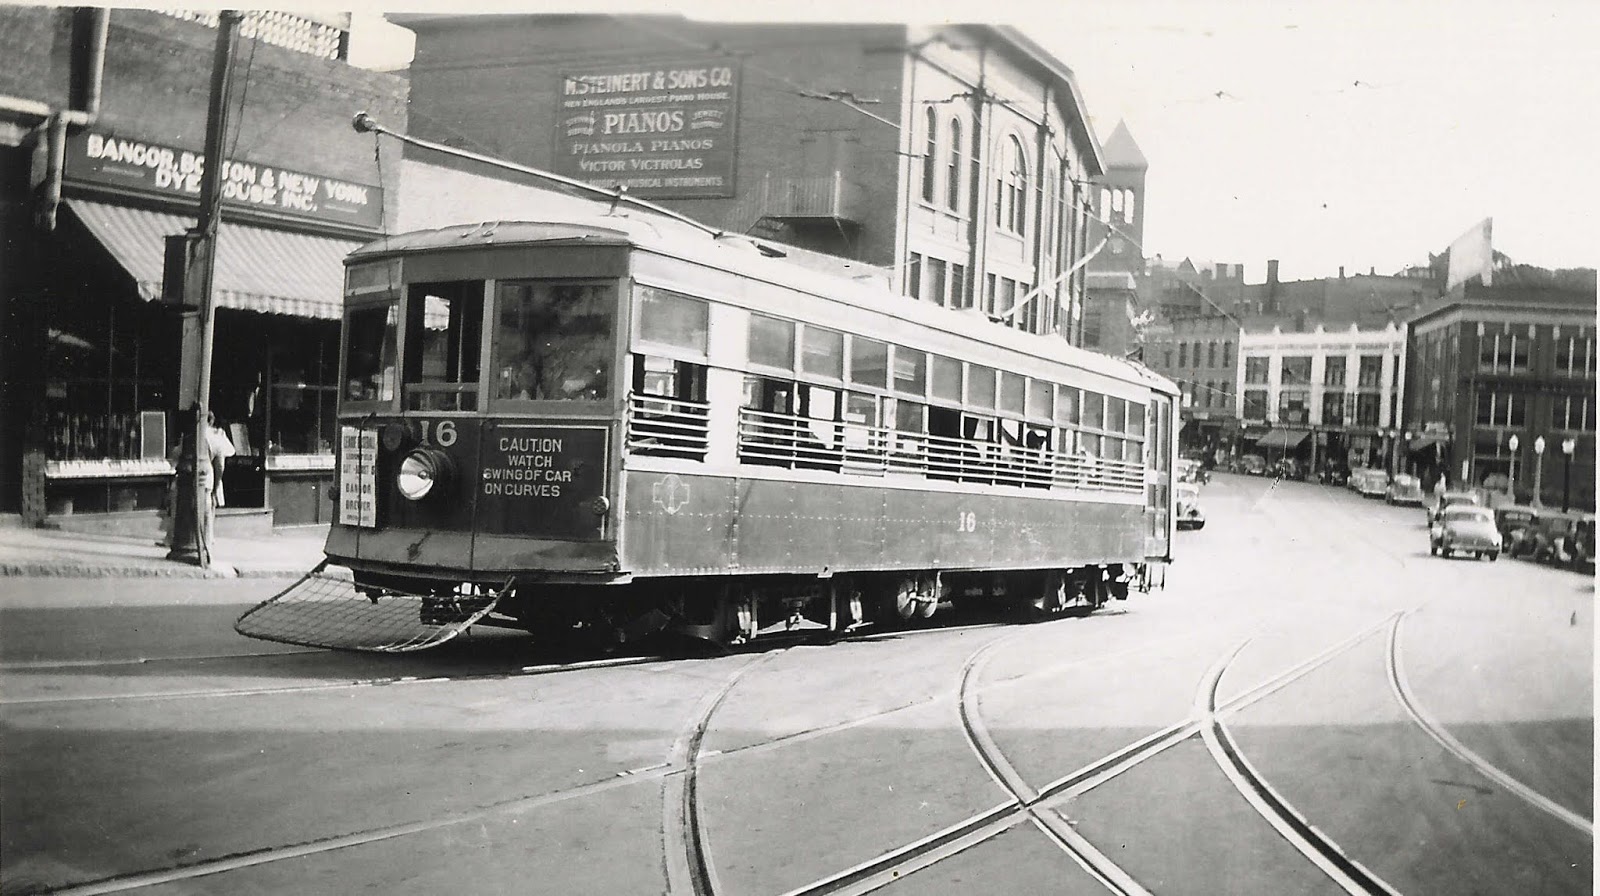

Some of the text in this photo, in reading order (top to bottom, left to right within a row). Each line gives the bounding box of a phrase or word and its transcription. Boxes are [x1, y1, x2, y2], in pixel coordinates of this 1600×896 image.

[653, 71, 665, 89] &
[668, 69, 707, 89] SONS
[710, 67, 732, 87] CO.
[669, 94, 695, 103] PIANO
[604, 111, 684, 134] PIANOS
[572, 139, 713, 155] PIANOLA PIANOS
[580, 158, 703, 171] VICTOR VICTROLAS
[181, 151, 256, 184] BOTON
[261, 168, 275, 188] &
[278, 171, 320, 195] NEW
[325, 179, 368, 205] YORK
[281, 190, 318, 212] INC.
[420, 420, 457, 447] 16
[500, 437, 562, 453] CAUTION
[508, 454, 552, 468] WATCH
[483, 468, 572, 482] SWING OF CAR
[345, 482, 372, 495] BANOR
[485, 482, 560, 497] ON CURVES
[345, 499, 371, 512] BREER
[957, 511, 976, 533] 16
